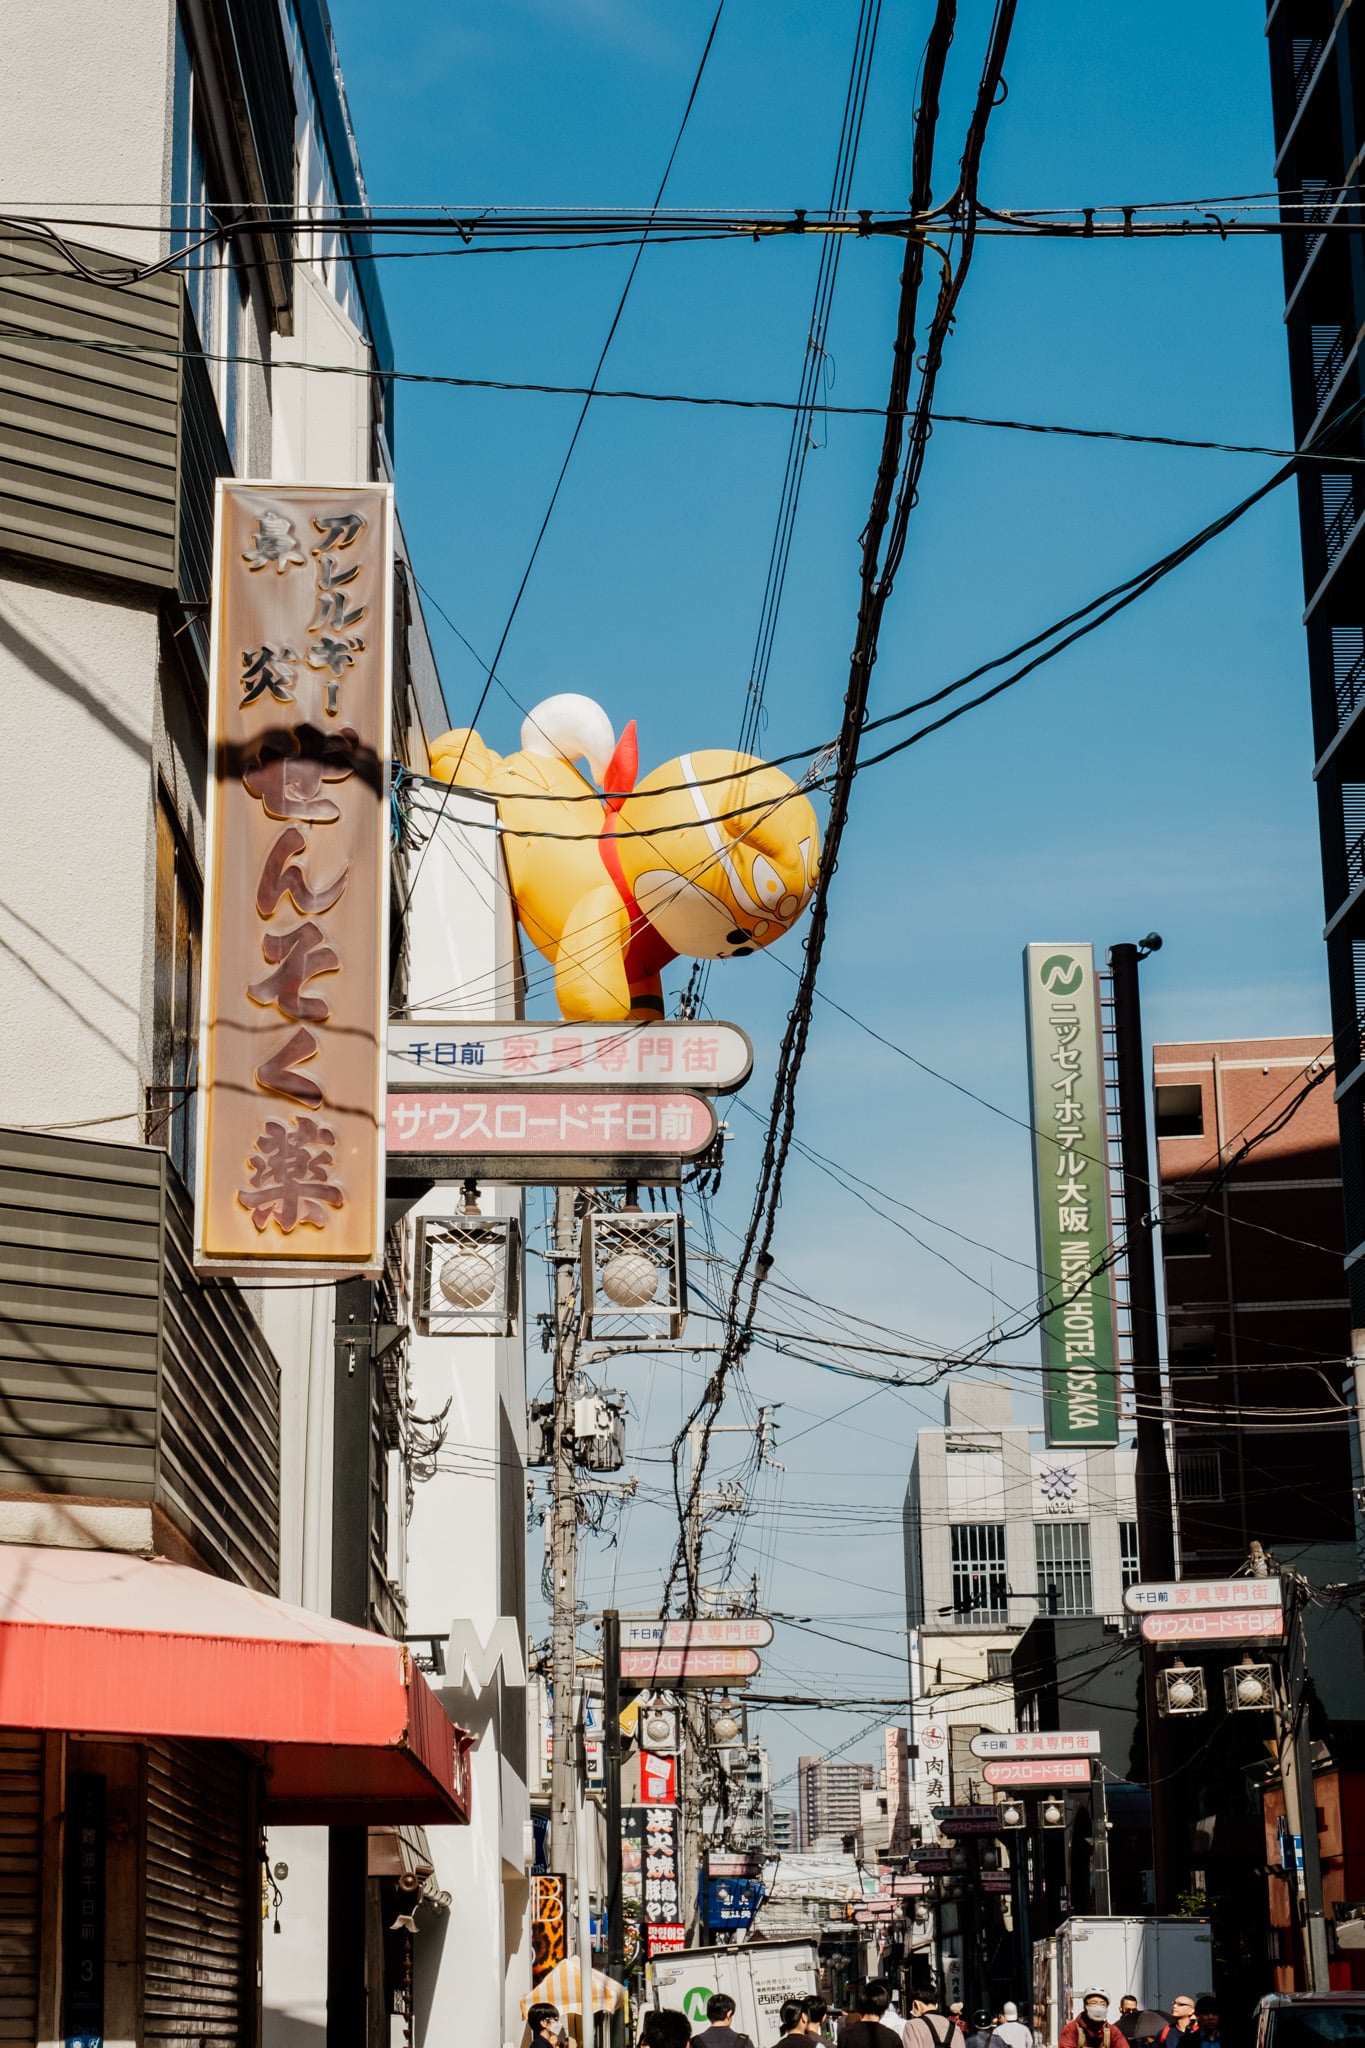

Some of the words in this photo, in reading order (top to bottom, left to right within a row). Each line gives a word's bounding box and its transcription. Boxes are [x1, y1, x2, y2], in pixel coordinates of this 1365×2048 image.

[239, 511, 304, 710] 鼻炎
[306, 512, 366, 717] アレルギー
[238, 723, 360, 1234] ぜんそく薬
[407, 1041, 486, 1066] 千日前
[502, 1037, 720, 1073] 家具専門街
[391, 1103, 694, 1141] サウスロード千日前
[1049, 1003, 1090, 1233] ニッセイホテル大阪
[1060, 1241, 1093, 1297] NISSEI
[1063, 1302, 1096, 1362] HOTEL
[1066, 1365, 1100, 1430] OSAKA
[1135, 1591, 1169, 1603] 千日前
[1175, 1584, 1268, 1604] 家具専門街
[630, 1628, 662, 1640] 千日前
[1149, 1613, 1278, 1635] サウスロード千日前
[625, 1653, 750, 1672] サウスロード千日前
[981, 1740, 1008, 1750] 千日前
[1015, 1735, 1089, 1751] 家具専門街
[990, 1764, 1085, 1779] サウスロード千日前
[80, 1827, 96, 1940] 難波千日前
